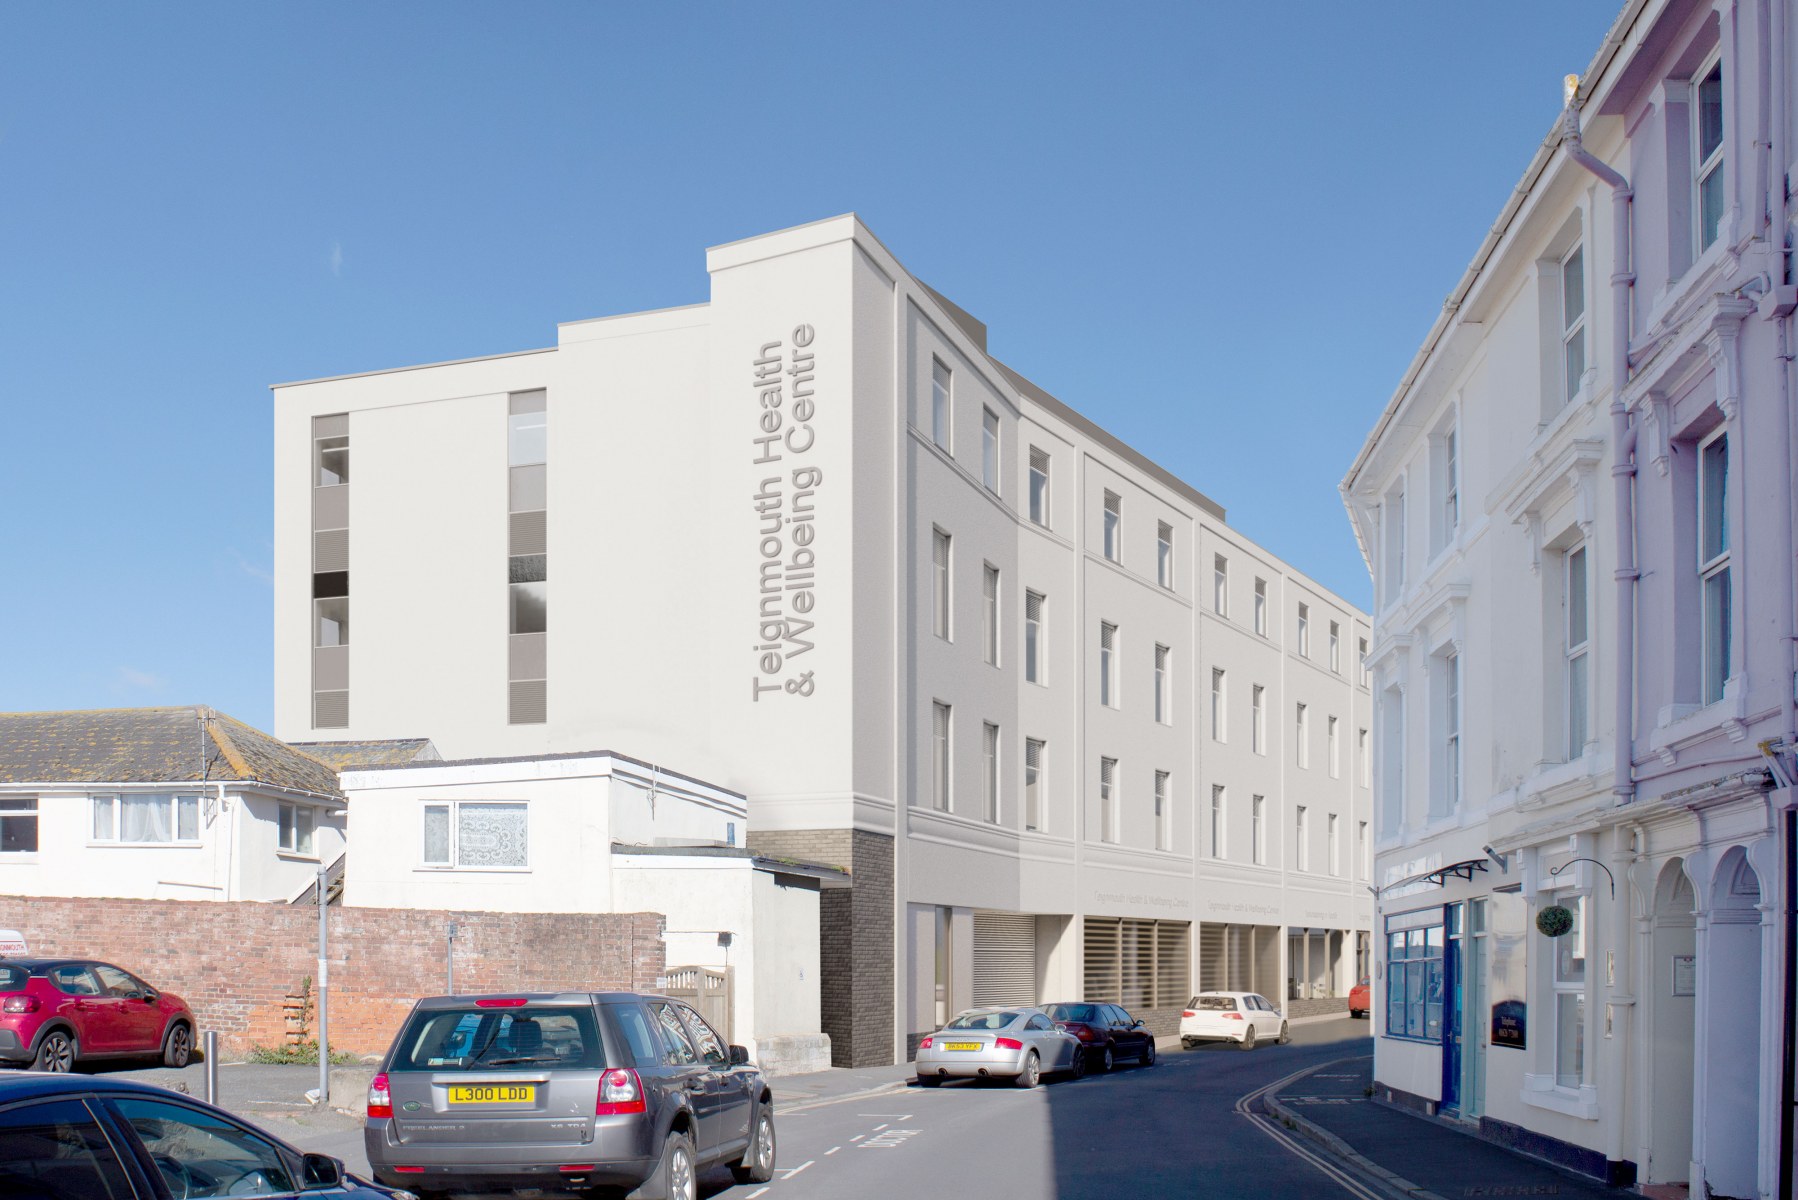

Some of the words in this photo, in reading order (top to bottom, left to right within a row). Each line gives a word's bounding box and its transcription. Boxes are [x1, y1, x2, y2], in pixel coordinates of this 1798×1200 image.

[753, 340, 782, 464] Health
[785, 323, 815, 454] Centre
[753, 476, 790, 702] Teignmouth
[785, 466, 823, 660] Wellbeing
[785, 670, 815, 697] &
[455, 1087, 494, 1101] L300
[498, 1087, 528, 1101] LDD
